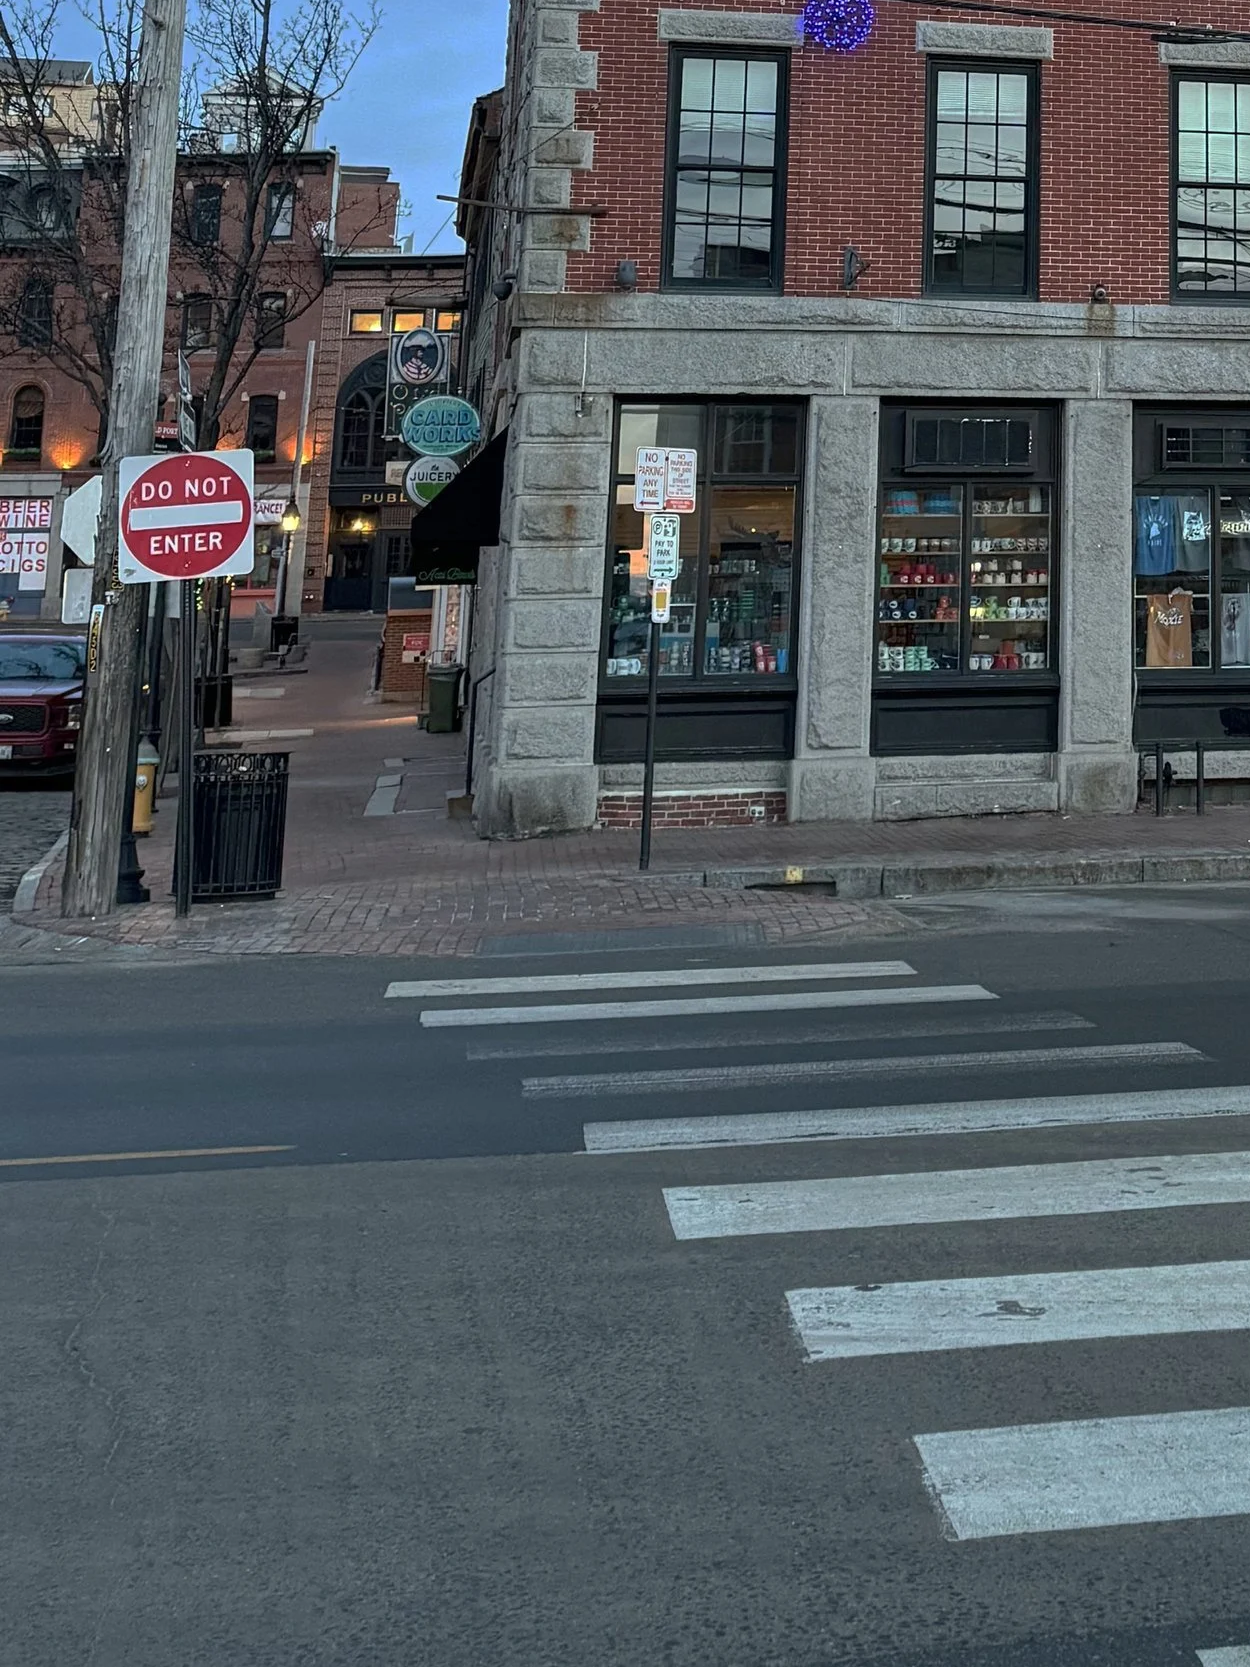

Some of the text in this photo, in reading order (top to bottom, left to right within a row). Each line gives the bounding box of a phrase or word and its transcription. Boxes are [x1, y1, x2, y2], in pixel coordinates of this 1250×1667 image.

[411, 409, 472, 427] CARD
[404, 427, 481, 444] WORKS
[645, 453, 658, 463] NO
[639, 465, 664, 477] PARKING
[141, 476, 232, 501] DO NOT
[643, 478, 658, 487] ANY
[361, 492, 408, 503] PUBL
[642, 489, 658, 498] TIME
[0, 500, 50, 514] BEER
[0, 513, 49, 527] WINE
[0, 541, 48, 555] OTTO
[150, 531, 223, 555] ENTER
[655, 540, 674, 548] PAY TO
[656, 549, 671, 557] PARK
